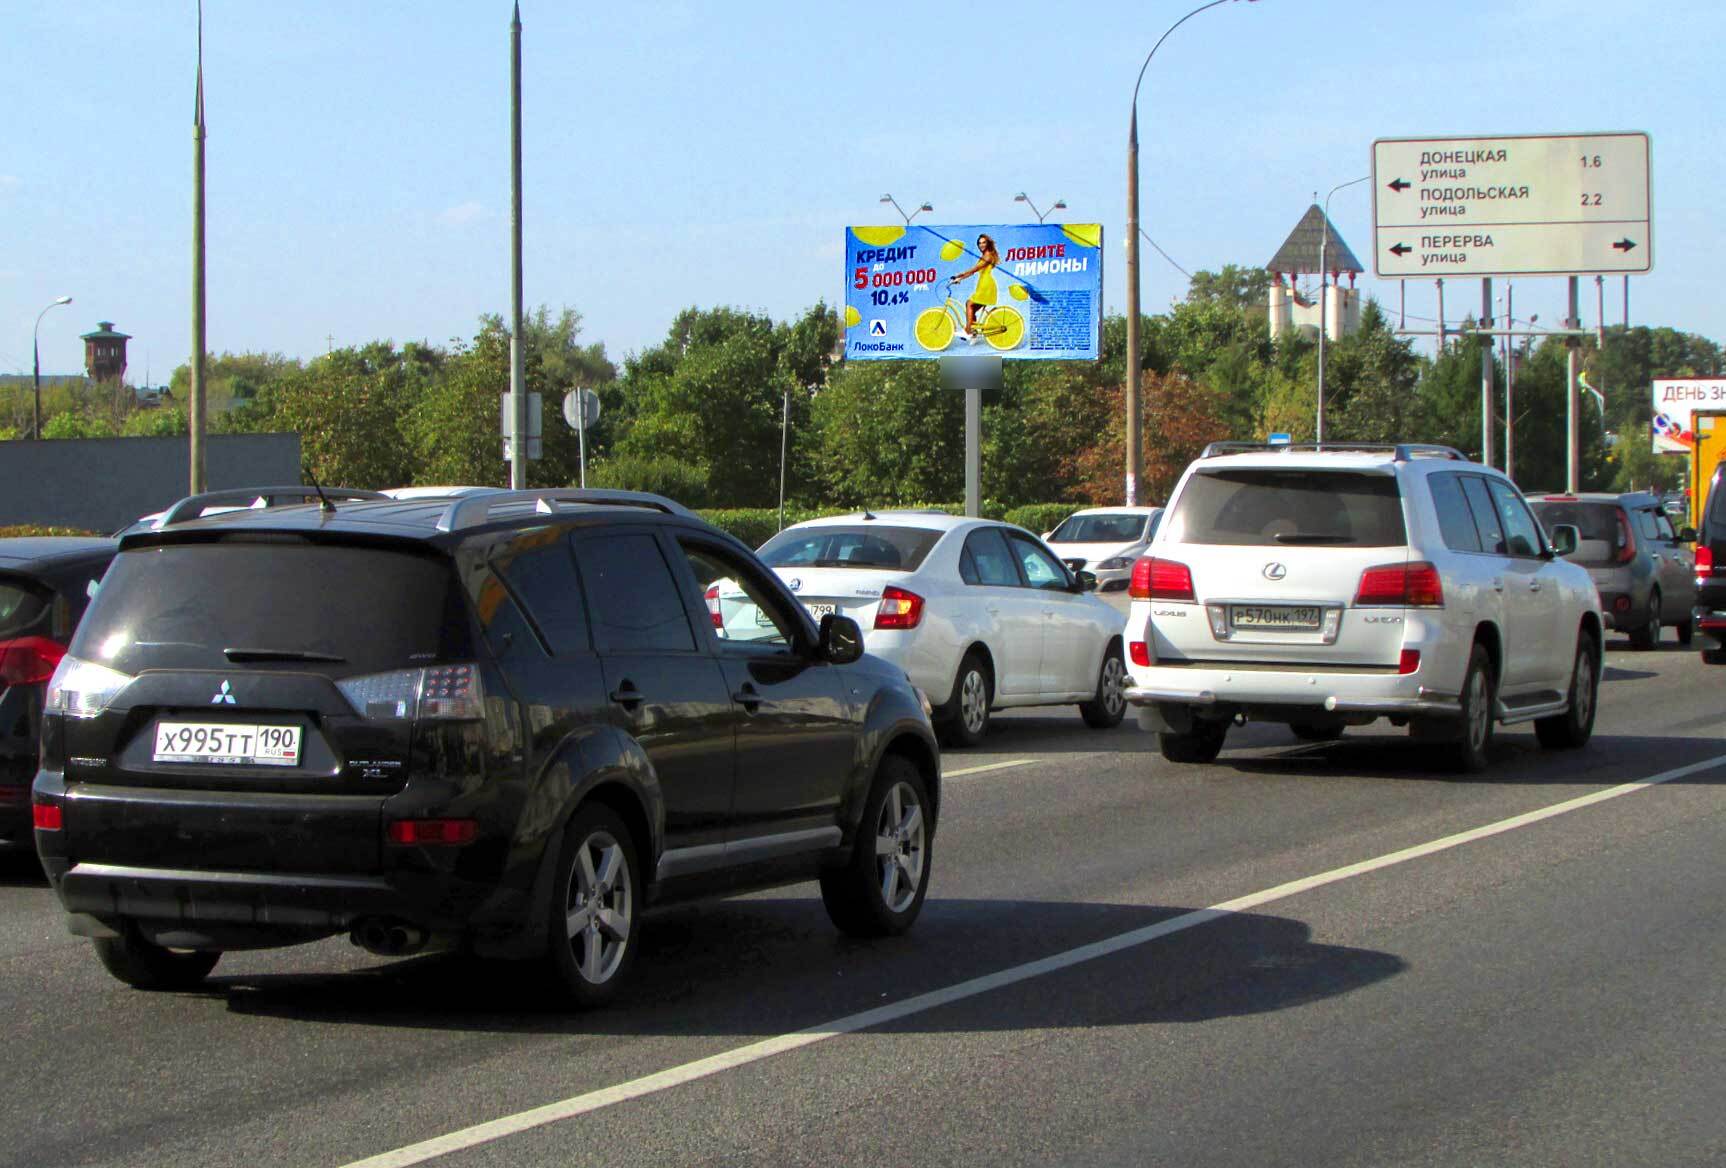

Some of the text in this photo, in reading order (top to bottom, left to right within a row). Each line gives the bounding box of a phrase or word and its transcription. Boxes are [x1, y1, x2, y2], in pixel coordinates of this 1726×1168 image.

[1420, 149, 1507, 166] ДОНЕЦКАЯ
[1580, 155, 1602, 168] 1.6
[1420, 168, 1466, 182] улица
[1420, 186, 1529, 202] ПОДОЛЬСКАЯ
[1580, 193, 1602, 206] 2.2
[1420, 205, 1466, 219] улица
[1421, 235, 1494, 249] ПЕРЕРВА
[856, 245, 917, 264] КРЕДИТ
[1005, 243, 1066, 262] ЛОВИТЕ
[1421, 253, 1467, 266] улица
[1013, 256, 1088, 276] ЛИМОНЫ
[854, 266, 937, 290] 5 000 000
[854, 341, 905, 351] ЛокоБанк
[1662, 386, 1706, 402] ДЕНЬ
[163, 727, 293, 754] Х995ТТ 190
